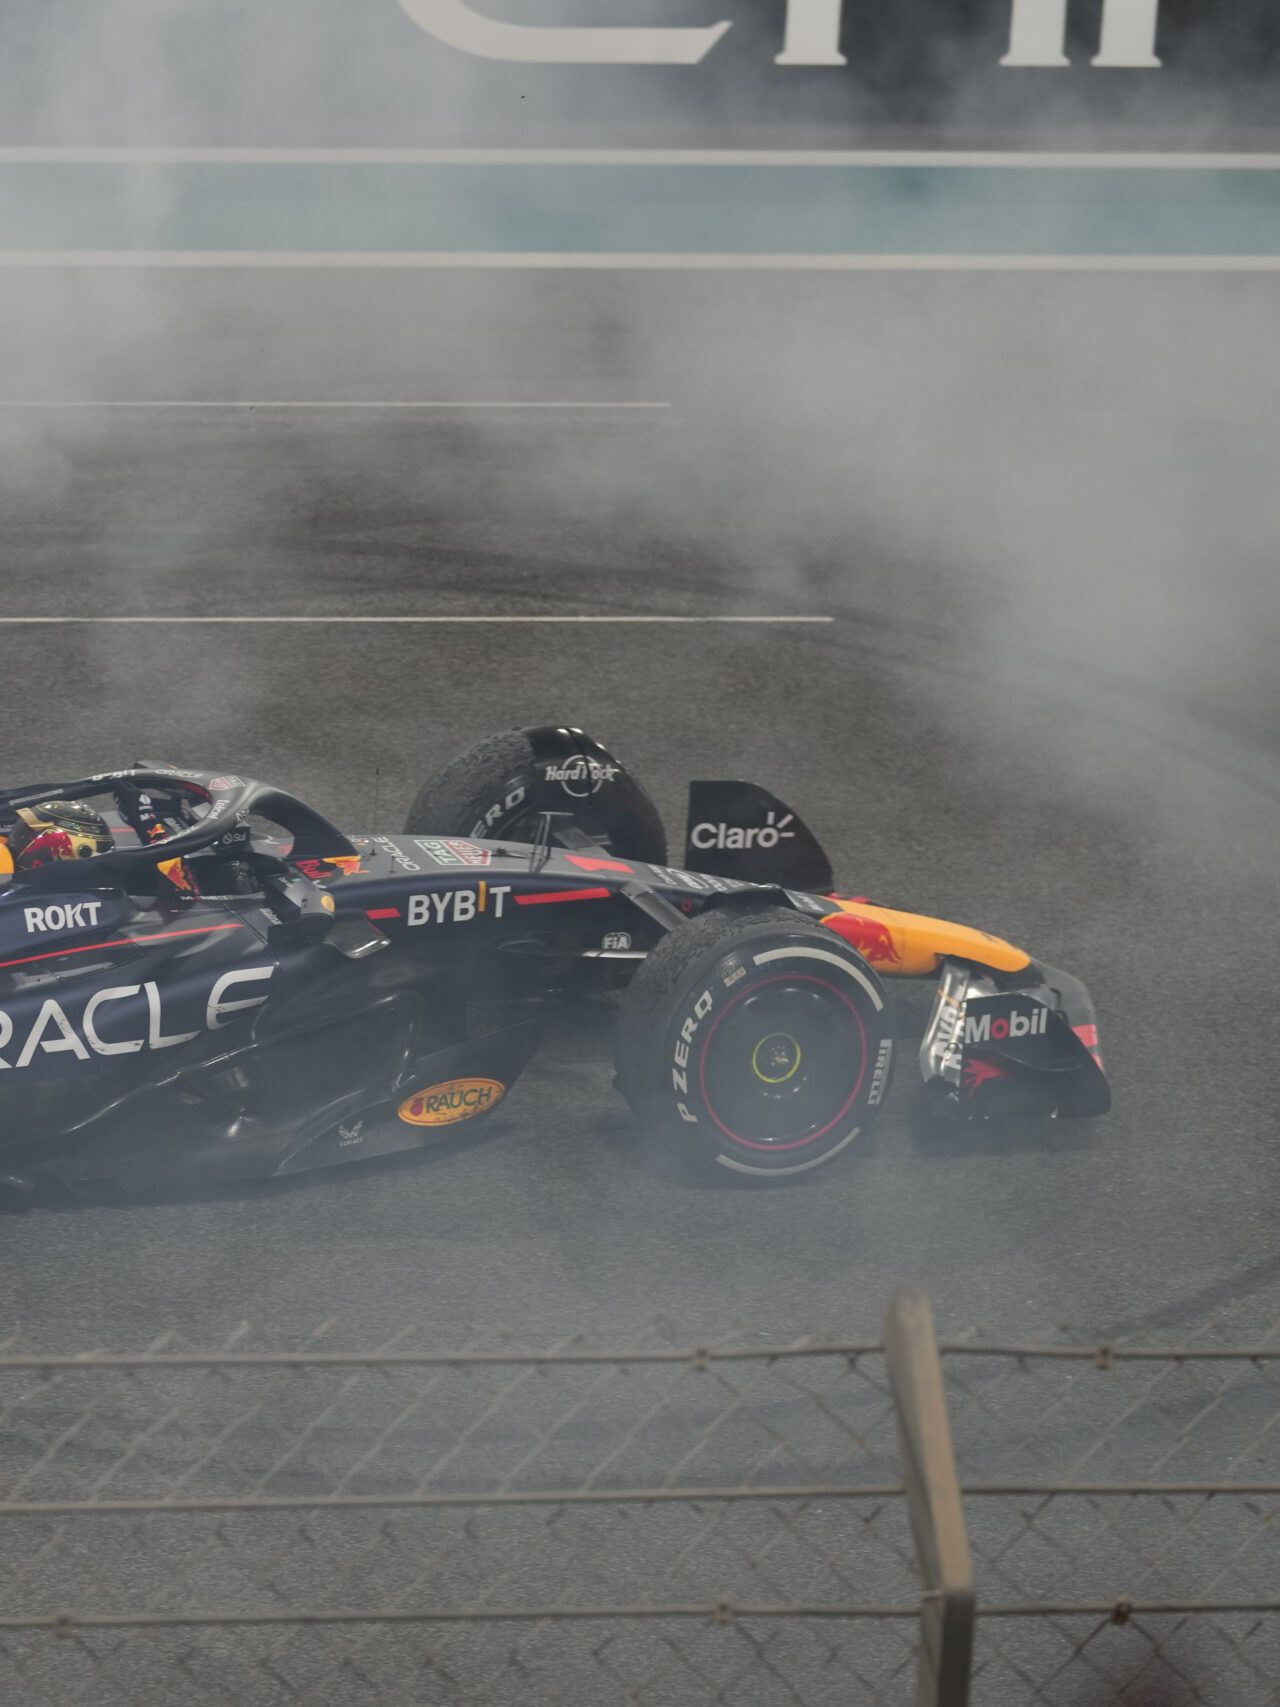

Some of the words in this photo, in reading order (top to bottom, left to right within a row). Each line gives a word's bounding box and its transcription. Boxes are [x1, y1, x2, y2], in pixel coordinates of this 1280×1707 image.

[545, 765, 581, 781] Hard
[471, 786, 525, 838] ERO
[691, 823, 779, 849] Claro
[24, 902, 102, 933] ROKT
[407, 880, 511, 926] BYBIT
[672, 989, 713, 1095] ZERO
[965, 1008, 1048, 1044] Mobil
[867, 1039, 892, 1105] PIRELLI
[425, 1086, 493, 1113] RAUCH
[676, 1102, 698, 1122] P
